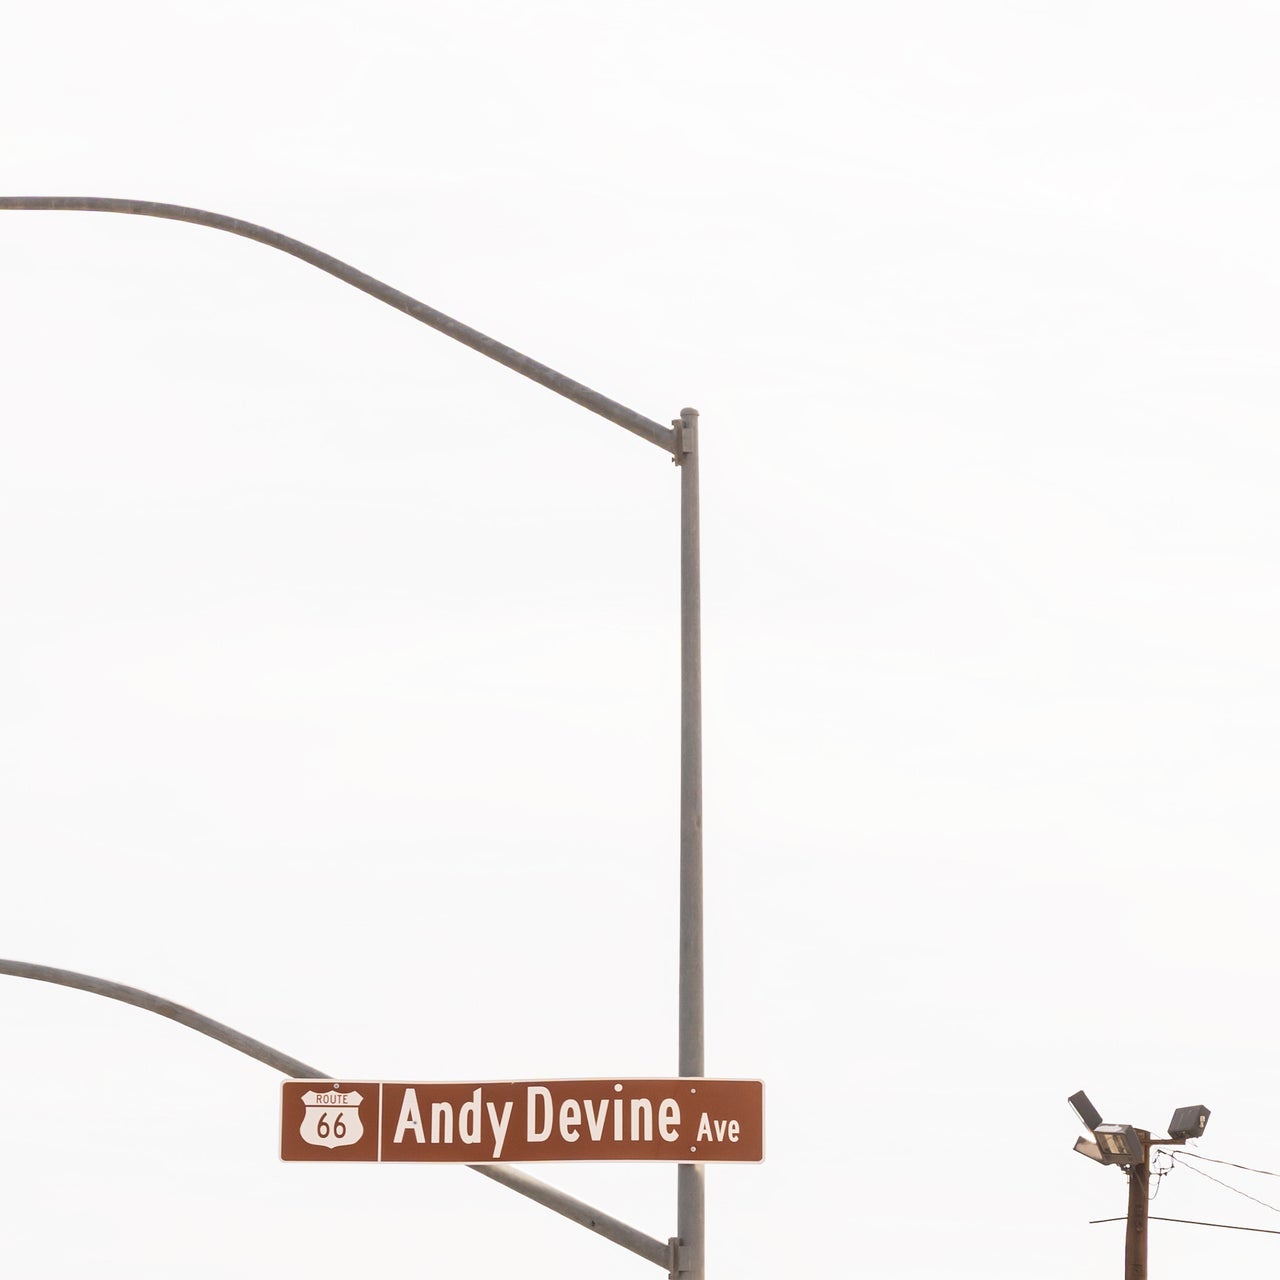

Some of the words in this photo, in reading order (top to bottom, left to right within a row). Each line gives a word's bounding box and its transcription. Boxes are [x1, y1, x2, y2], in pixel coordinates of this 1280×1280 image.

[316, 1093, 349, 1105] ROUTE
[316, 1112, 347, 1139] 66
[393, 1086, 514, 1159] Andy
[526, 1083, 682, 1143] Devine
[696, 1112, 741, 1143] Ave
